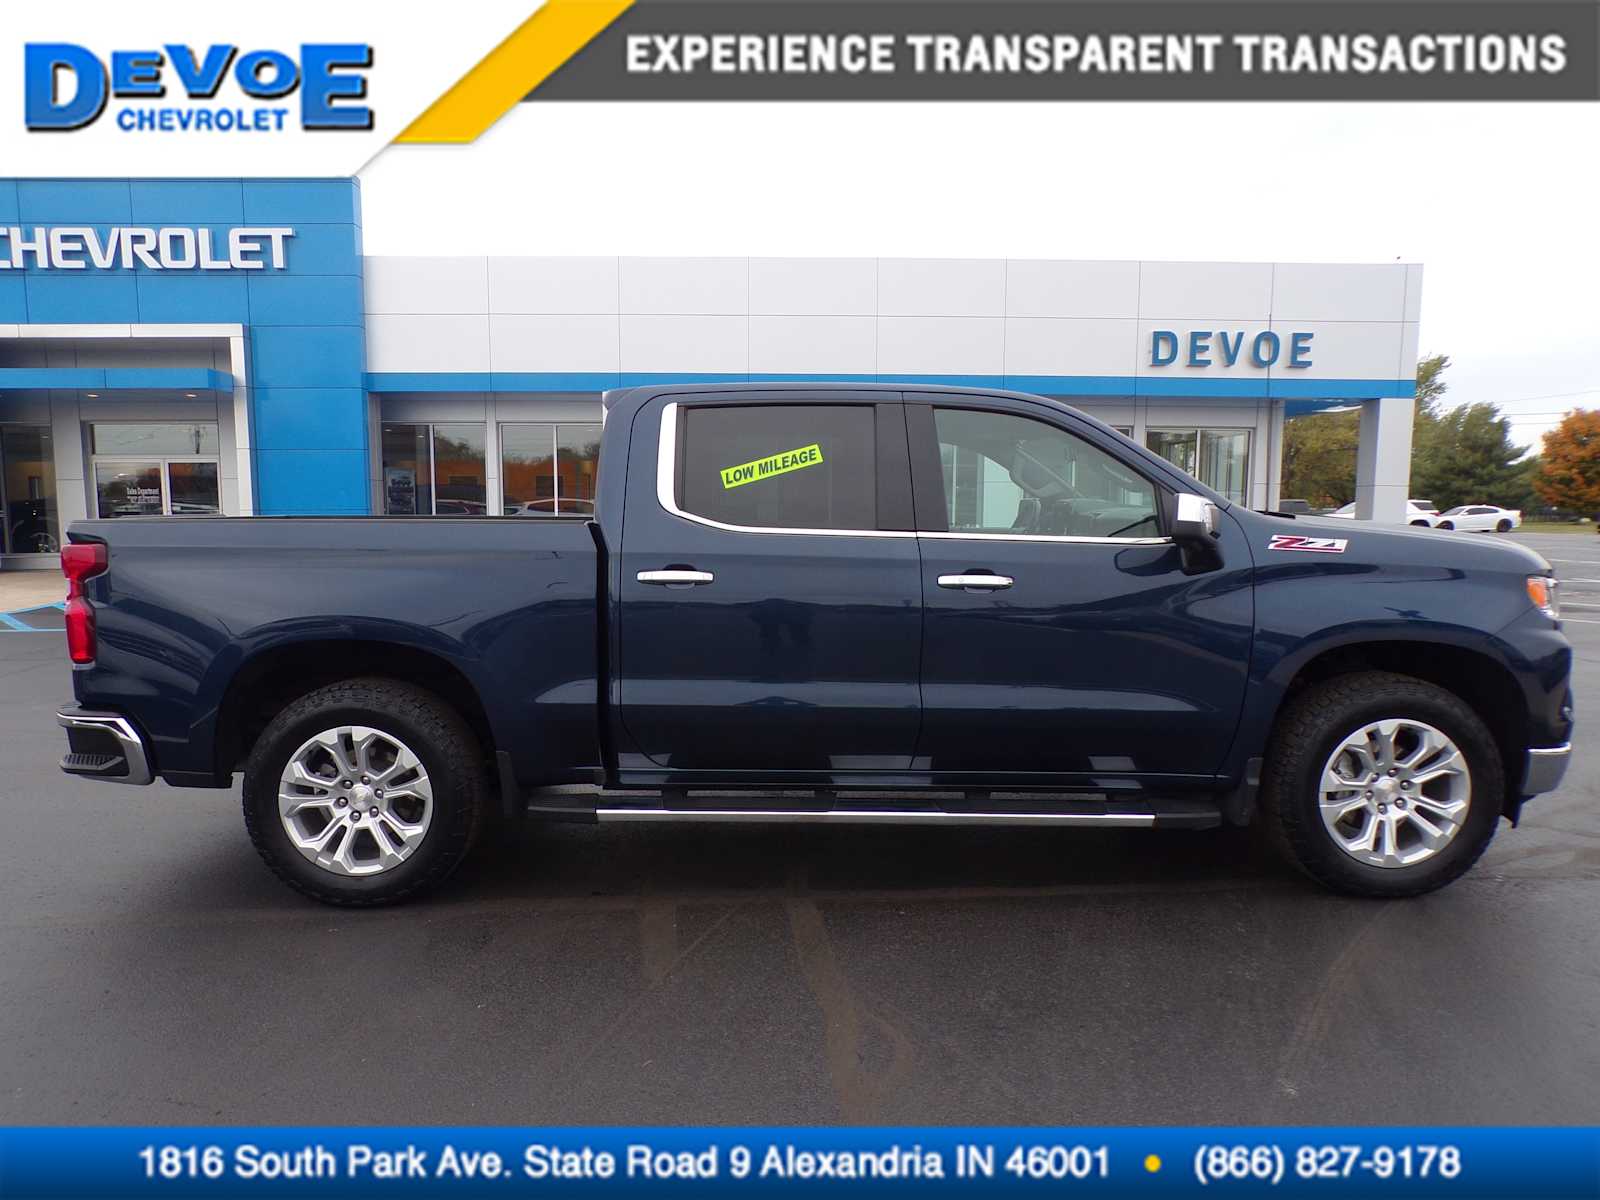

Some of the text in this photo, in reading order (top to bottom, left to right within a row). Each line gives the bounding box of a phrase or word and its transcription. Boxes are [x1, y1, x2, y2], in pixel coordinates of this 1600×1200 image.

[1150, 330, 1314, 369] DEVOE
[725, 448, 818, 485] LOW MILEAGE
